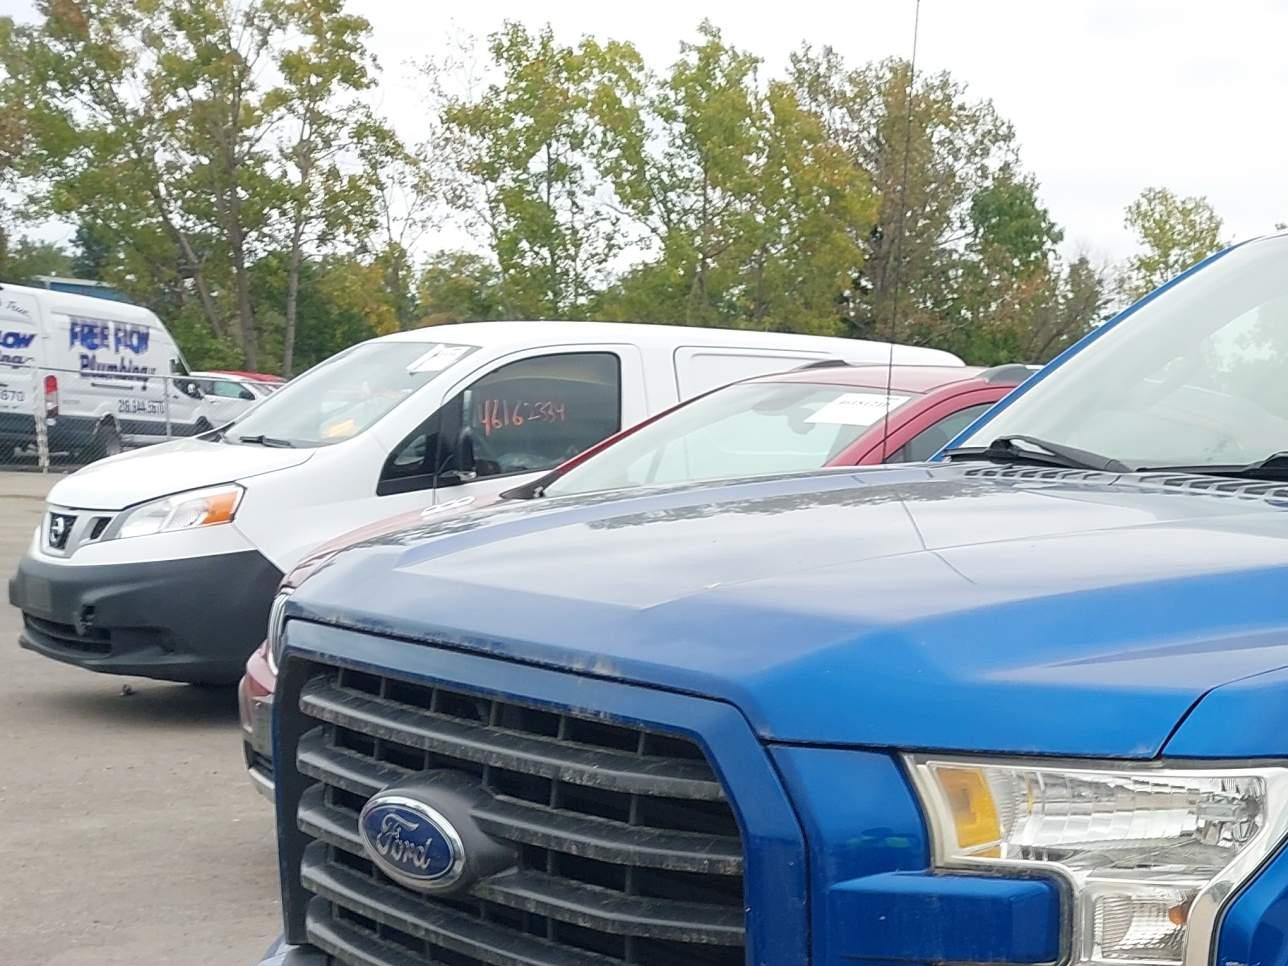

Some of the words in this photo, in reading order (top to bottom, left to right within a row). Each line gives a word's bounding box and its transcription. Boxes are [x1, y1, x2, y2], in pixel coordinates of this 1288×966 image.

[70, 321, 110, 350] FREE
[114, 326, 149, 354] FLOW
[376, 813, 433, 870] Ford
